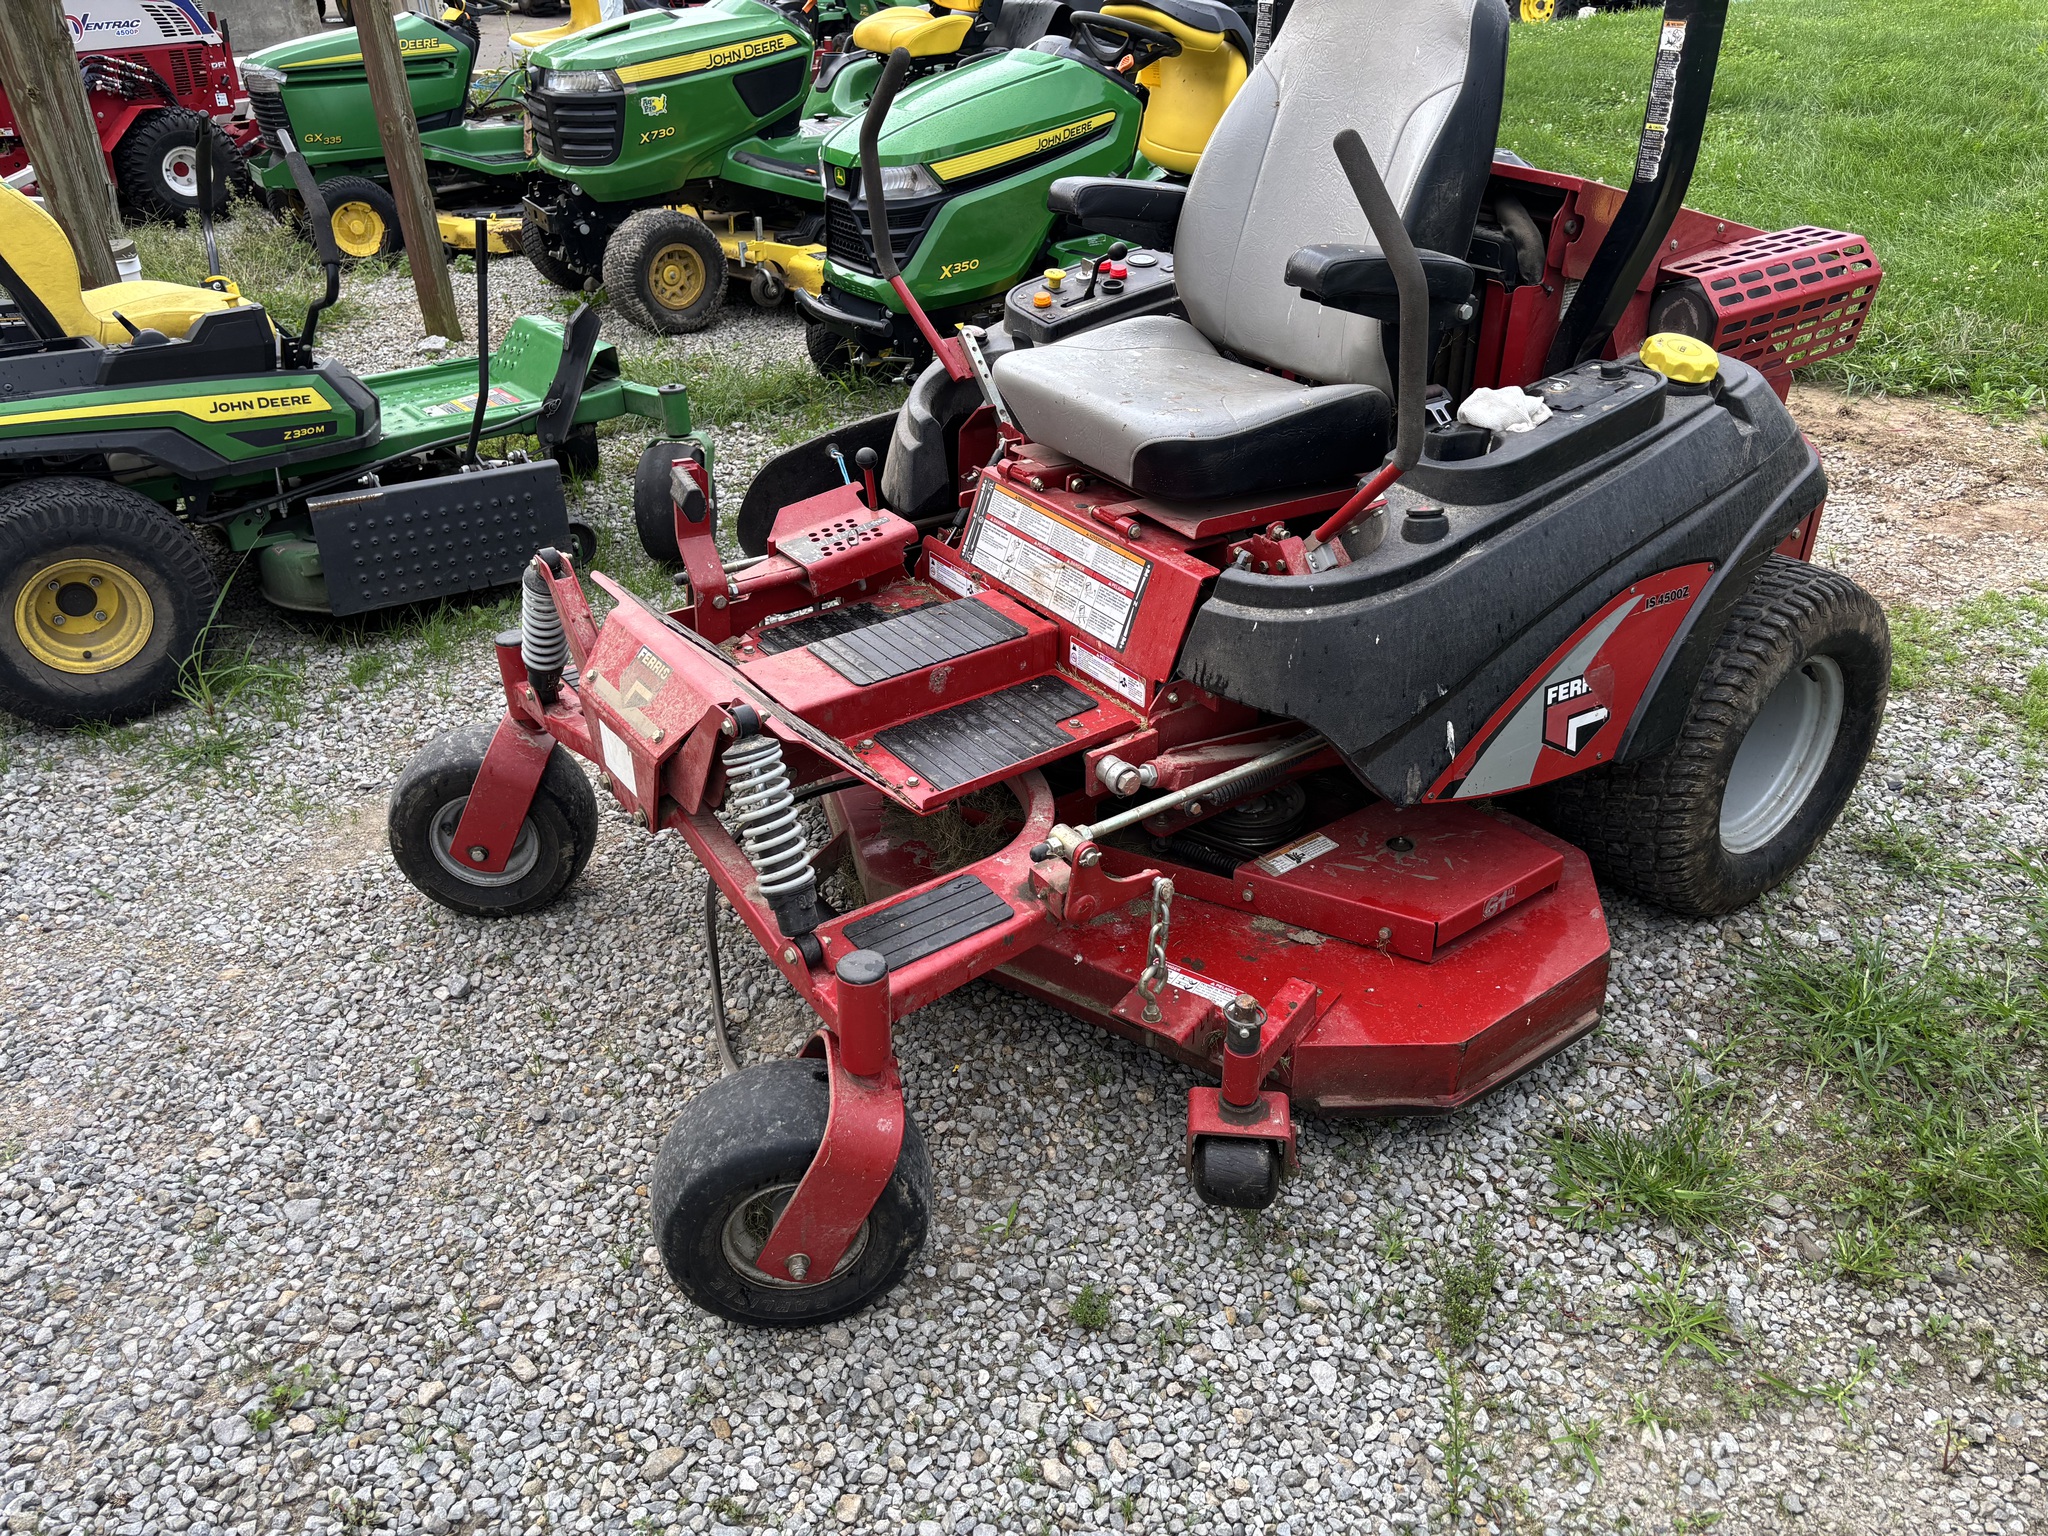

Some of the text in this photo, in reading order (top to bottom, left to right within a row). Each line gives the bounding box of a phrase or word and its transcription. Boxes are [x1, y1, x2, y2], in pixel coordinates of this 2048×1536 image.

[69, 13, 141, 36] VENTRAC
[399, 38, 439, 50] DEERE
[706, 37, 785, 69] JOHN DEERE
[304, 133, 342, 145] GX335
[639, 126, 676, 145] X730
[1035, 120, 1093, 152] JOHN DEERE
[939, 259, 980, 280] X350
[209, 394, 312, 414] JOHN DEERE
[283, 425, 325, 440] Z330M
[1645, 585, 1690, 609] IS 4500Z
[636, 646, 671, 681] FERRIS
[1164, 962, 1182, 972] ANGER
[1215, 982, 1238, 995] PELIGRO
